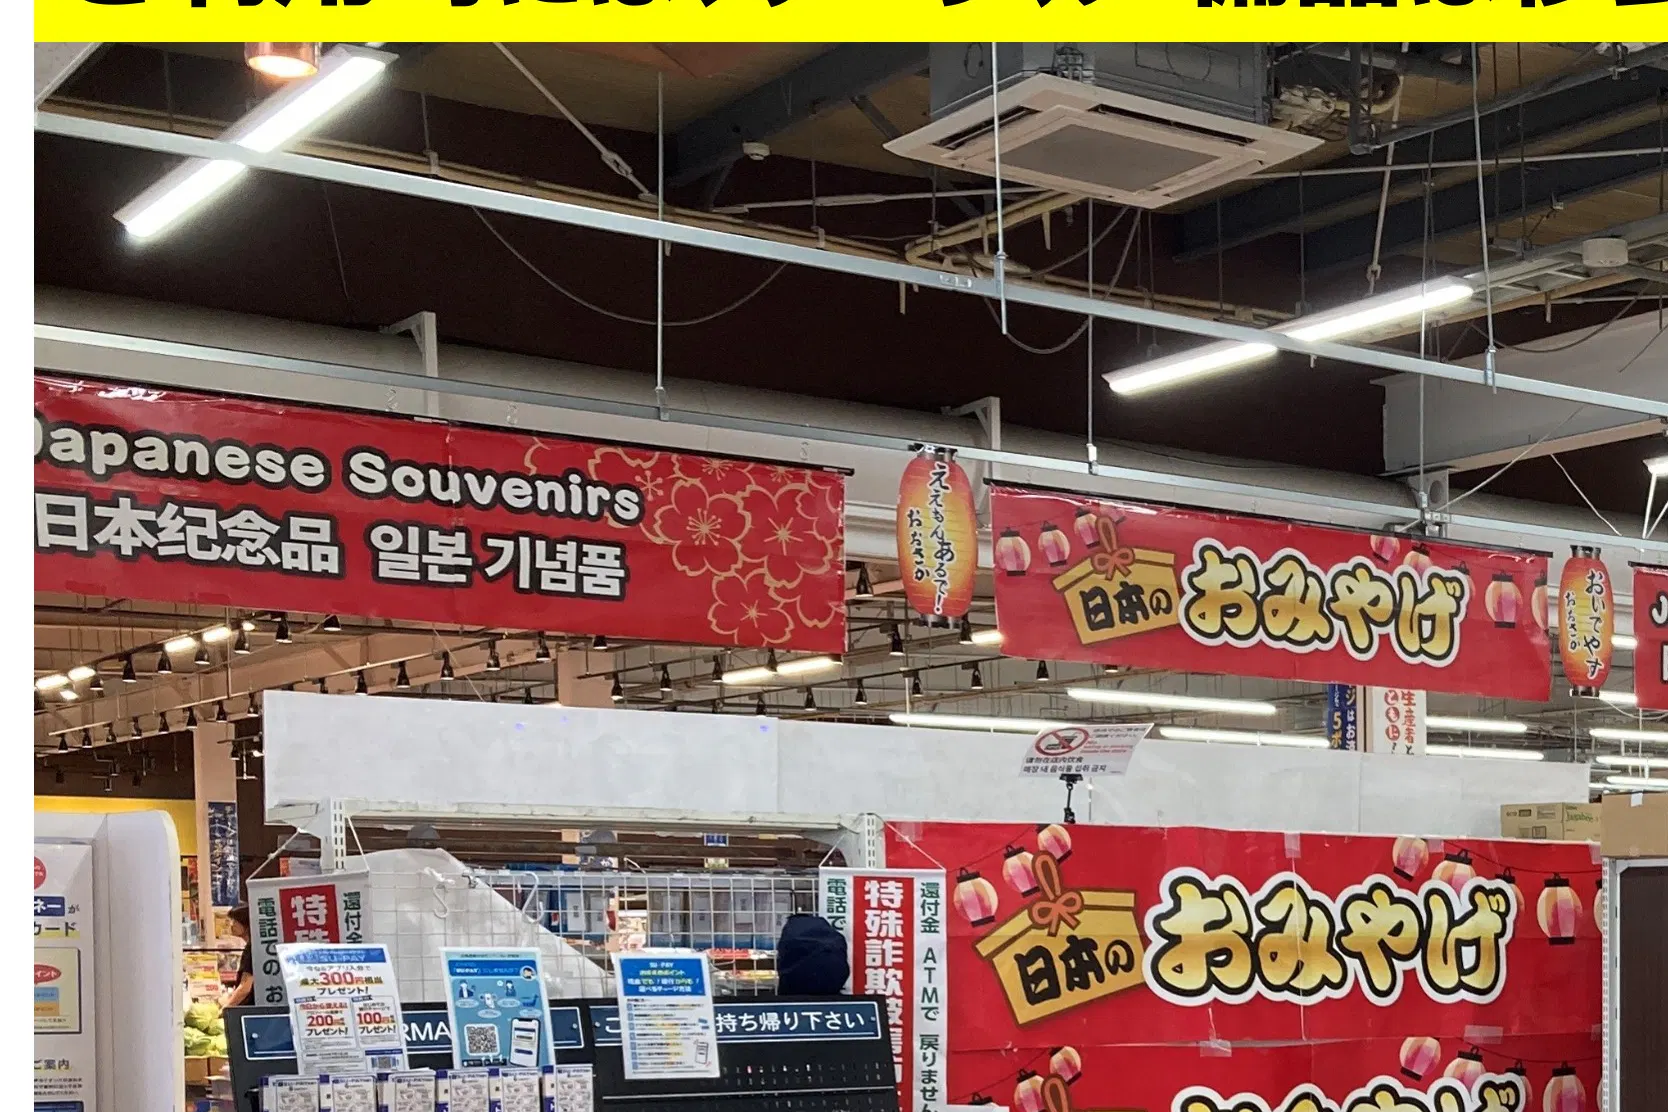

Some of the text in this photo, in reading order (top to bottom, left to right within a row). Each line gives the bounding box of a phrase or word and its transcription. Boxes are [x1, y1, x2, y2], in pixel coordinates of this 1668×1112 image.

[350, 452, 641, 521] Souvenirs
[36, 496, 339, 574] 日本纪念品
[371, 524, 625, 597] 일본 기념품
[1083, 544, 1469, 660] 日本の おみやげ
[1584, 570, 1605, 677] おいでやす
[920, 881, 940, 934] 還付金
[1013, 876, 1512, 1006] 日本の おみやげ
[922, 946, 940, 1022] ATMで
[716, 1011, 865, 1035] 持ち帰り下さい
